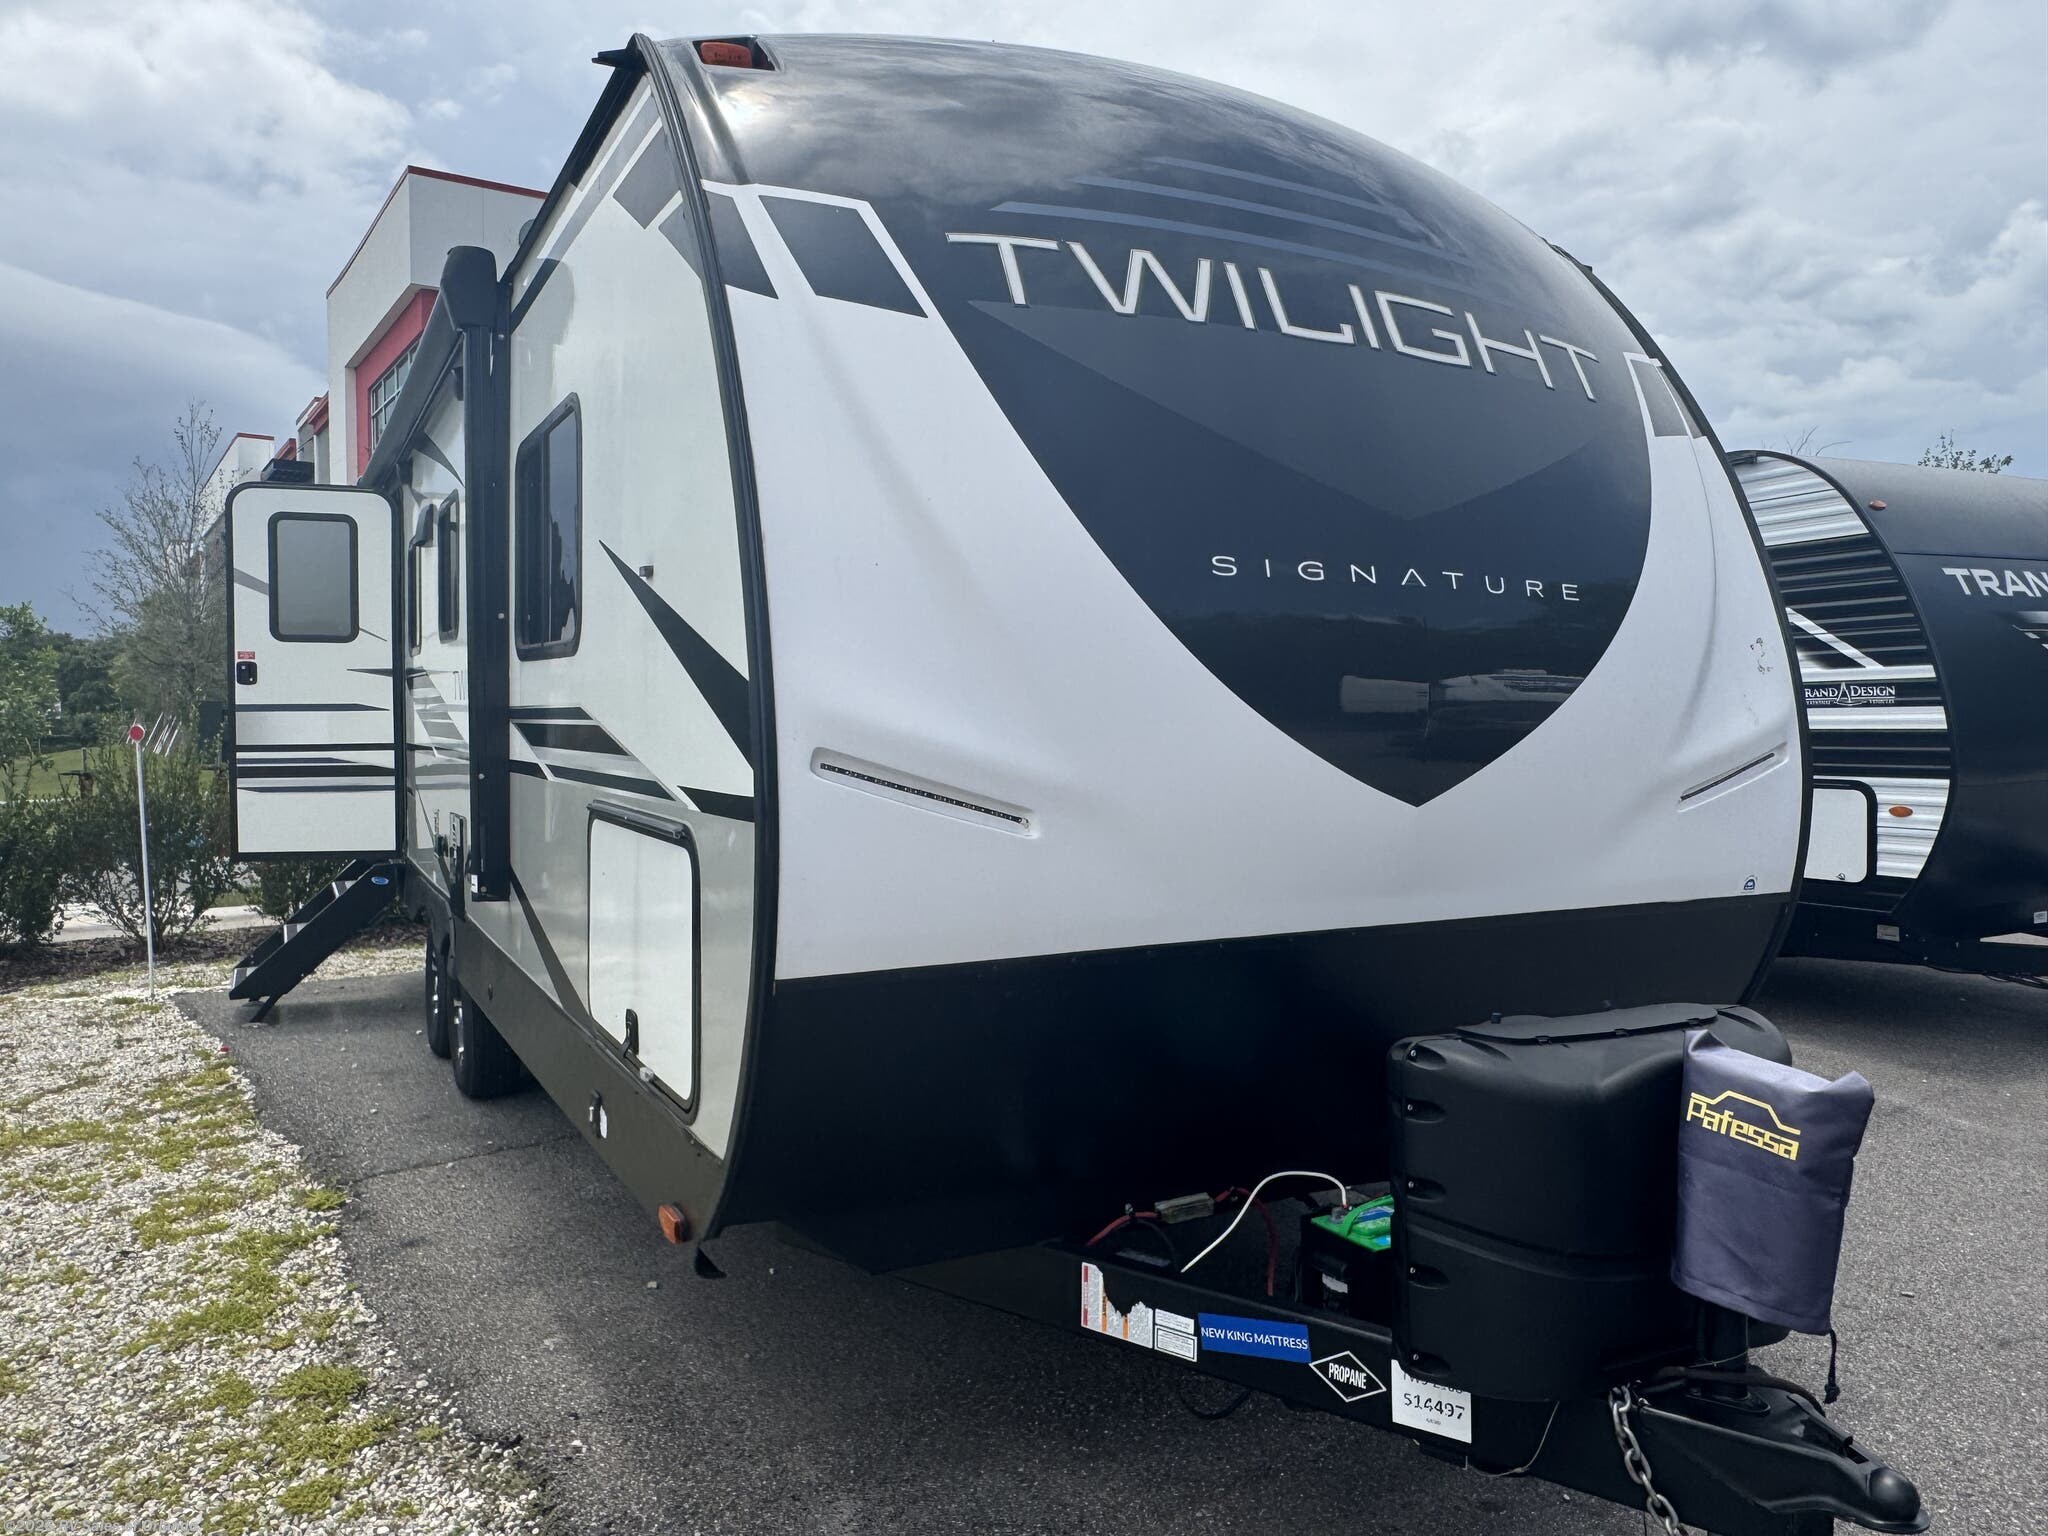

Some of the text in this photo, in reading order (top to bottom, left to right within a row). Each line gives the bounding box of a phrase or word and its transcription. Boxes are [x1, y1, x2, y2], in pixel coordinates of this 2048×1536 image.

[945, 232, 1599, 402] TWILIGHT
[1211, 555, 1581, 602] SIGNATURE
[1941, 567, 2048, 598] TRAN
[1804, 685, 1896, 698] RAND DESIGN
[1686, 1097, 1800, 1161] Pafessa
[1200, 1326, 1308, 1350] NEW KING MATTRESS
[1328, 1362, 1367, 1389] PROPANE
